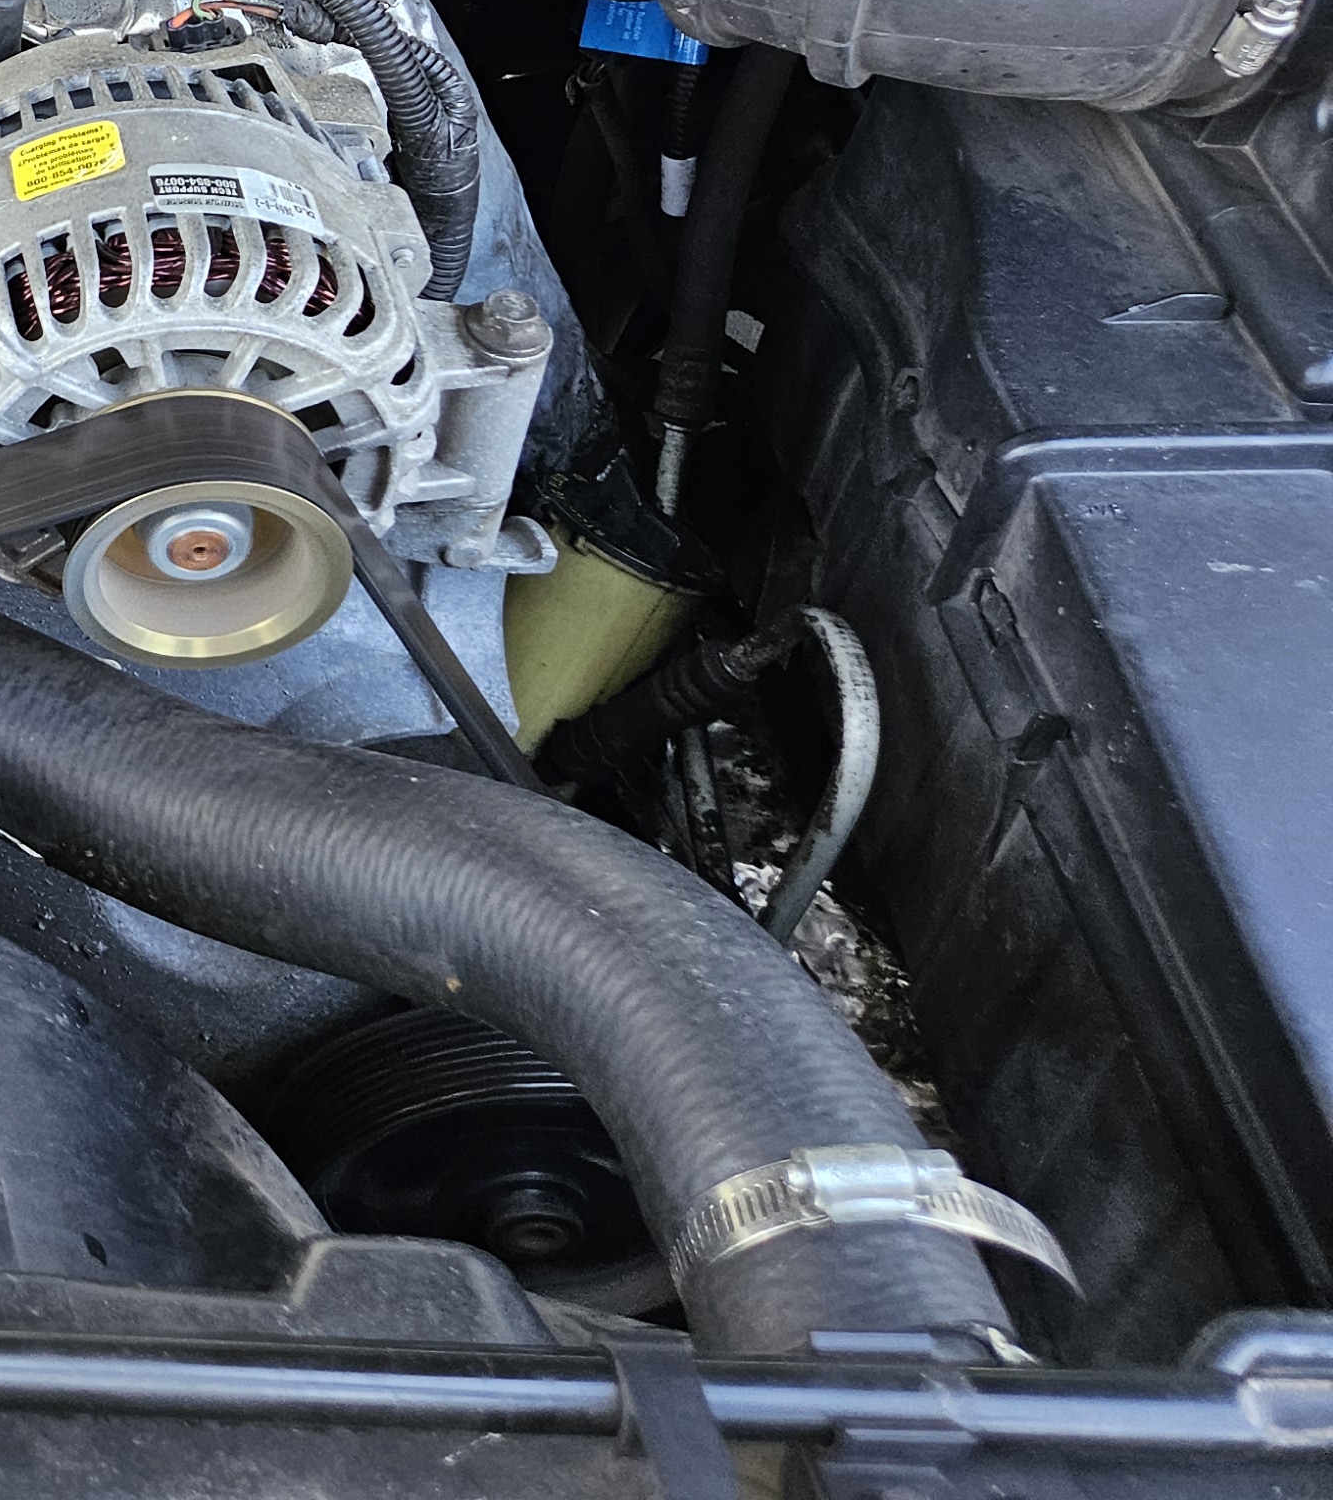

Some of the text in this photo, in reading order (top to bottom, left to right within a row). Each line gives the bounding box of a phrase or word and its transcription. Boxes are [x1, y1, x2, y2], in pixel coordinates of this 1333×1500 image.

[58, 125, 104, 142] Problems?
[155, 177, 237, 189] 800-854-0076
[158, 185, 239, 196] TECH SUPPORT
